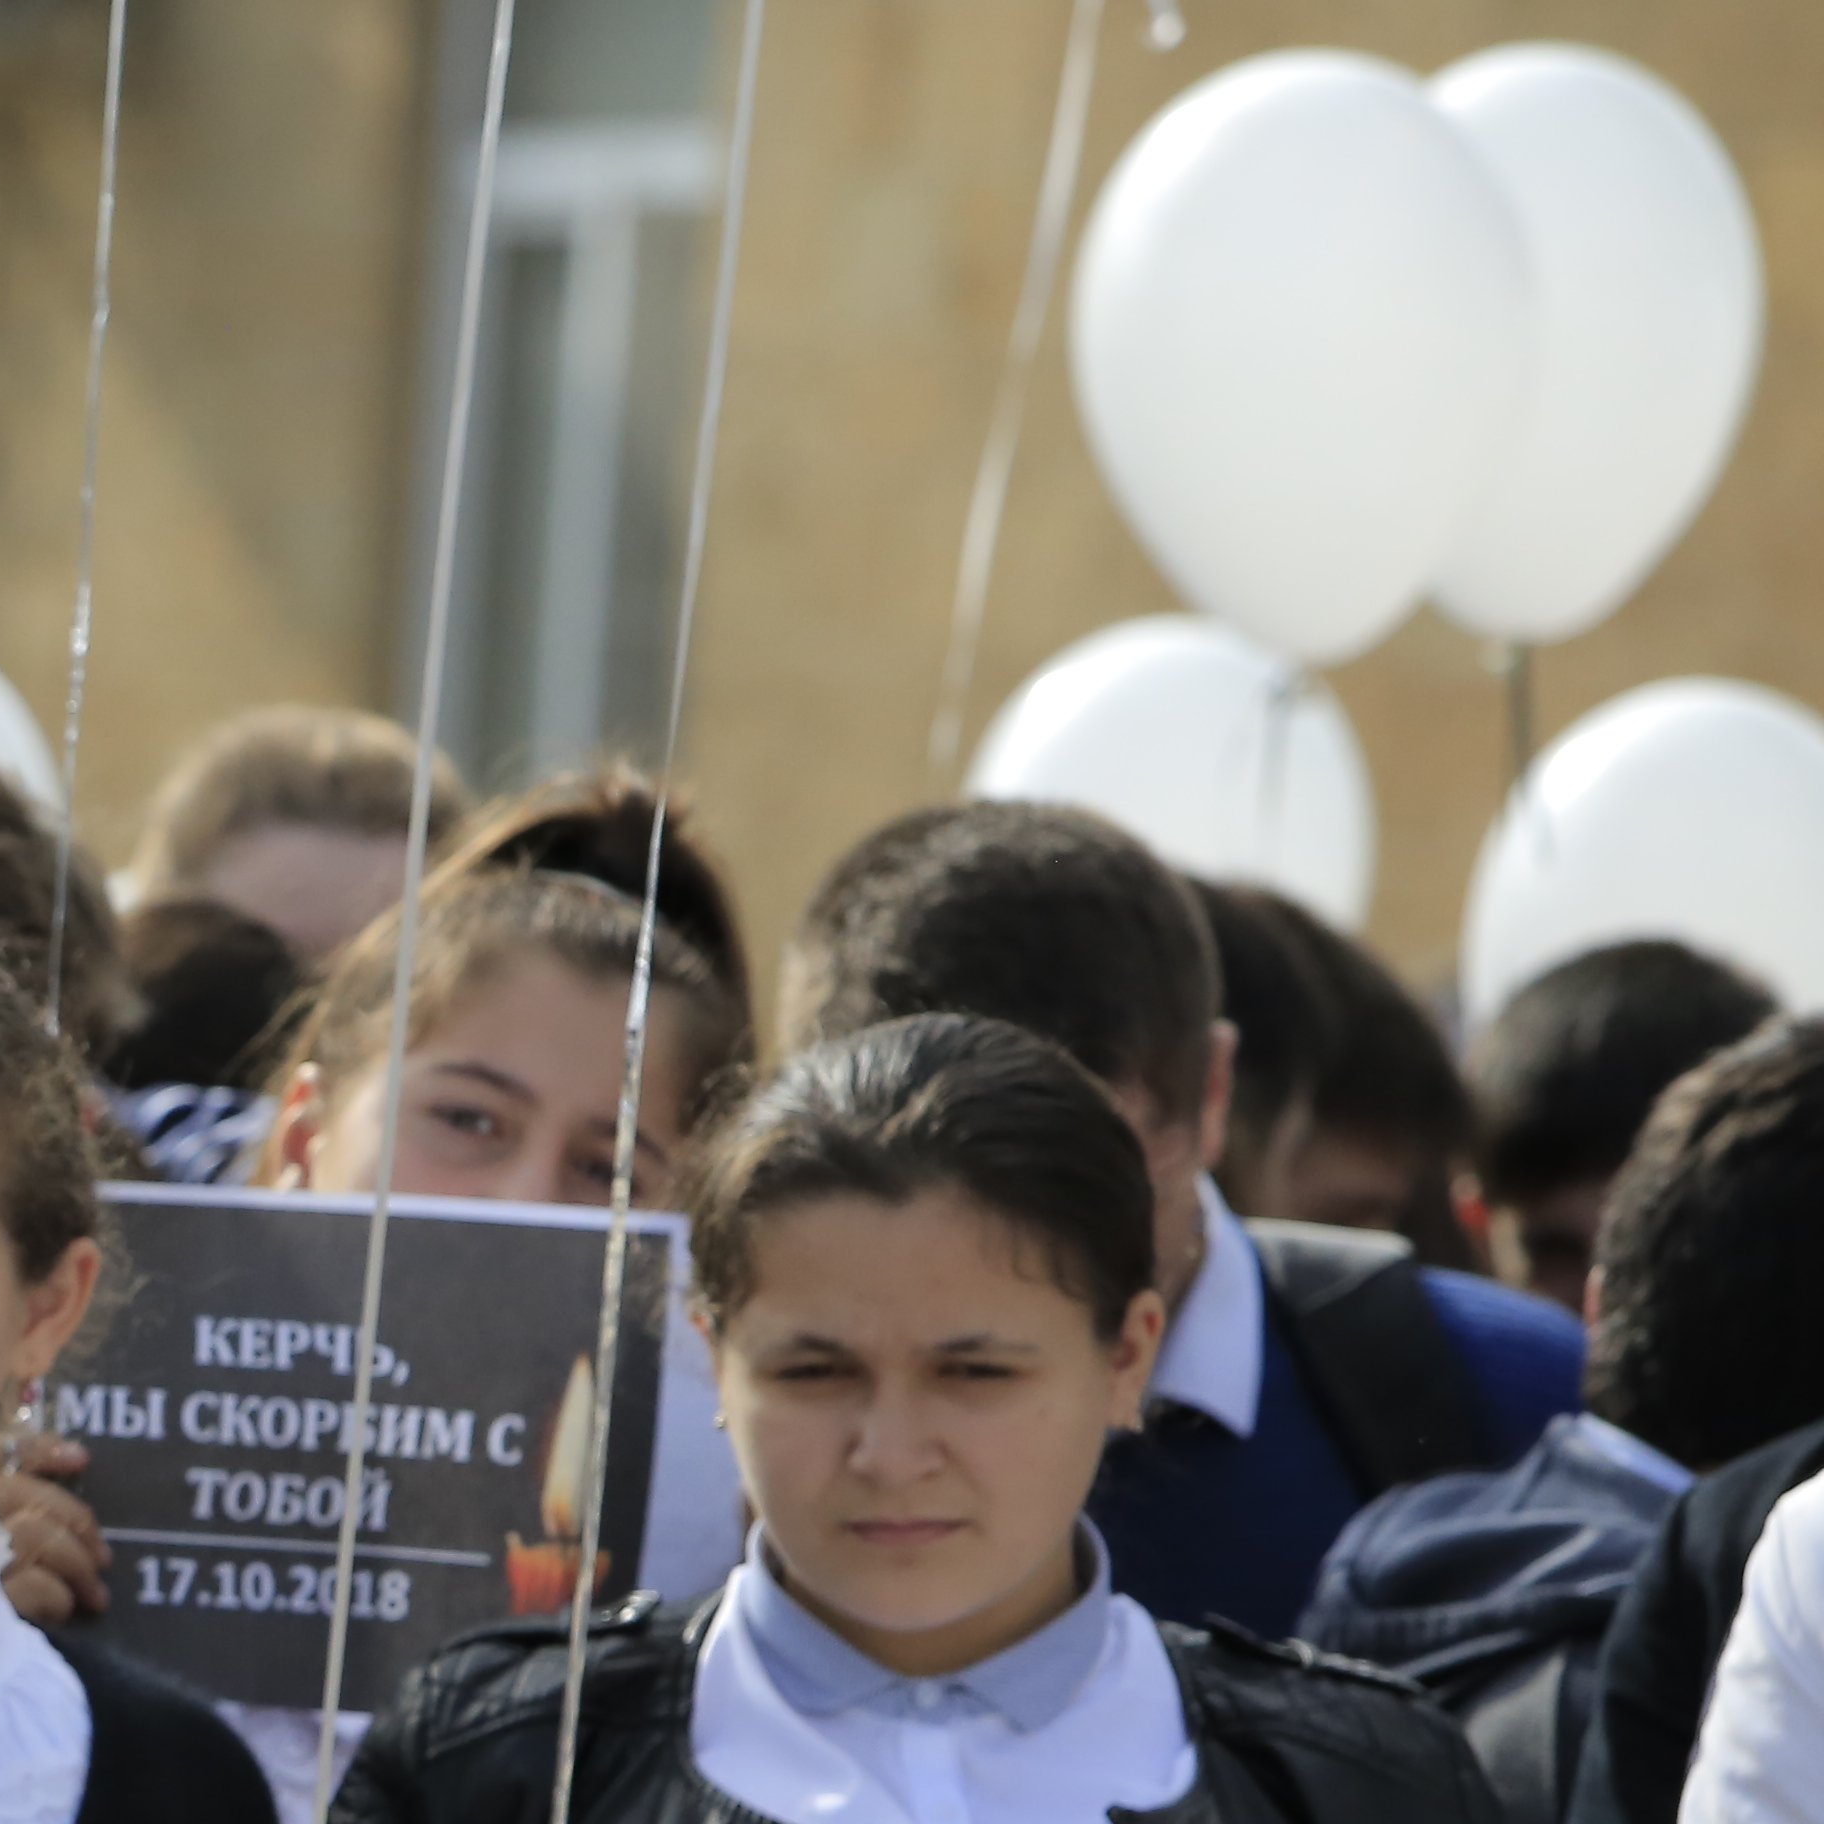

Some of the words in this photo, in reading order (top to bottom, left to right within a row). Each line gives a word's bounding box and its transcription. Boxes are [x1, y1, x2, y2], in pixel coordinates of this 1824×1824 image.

[193, 1315, 411, 1386] КЕРЧЬ,
[58, 1383, 166, 1438] МЫ
[181, 1392, 473, 1464] СКОРБИМ
[487, 1413, 526, 1465] С
[186, 1467, 393, 1532] ТОБОЙ
[137, 1557, 411, 1621] 17.10.2018
